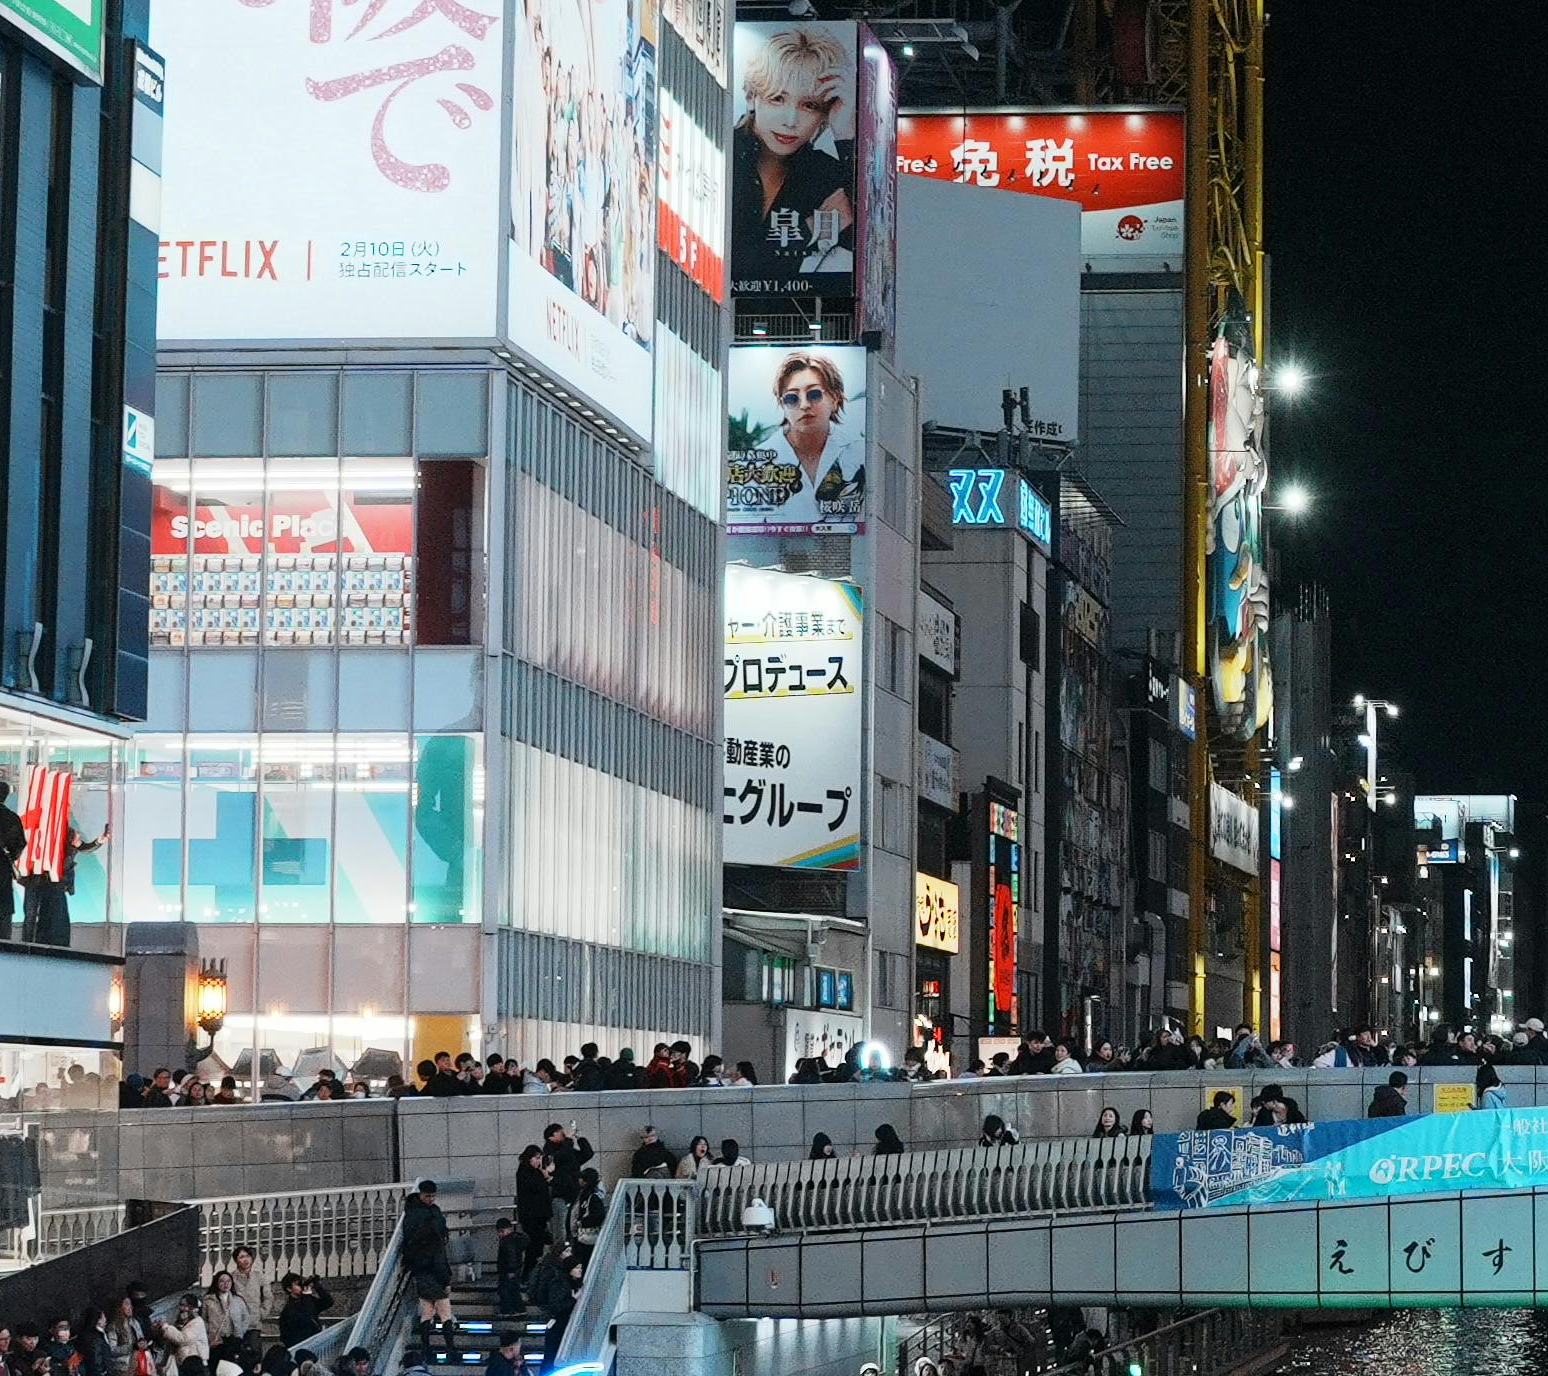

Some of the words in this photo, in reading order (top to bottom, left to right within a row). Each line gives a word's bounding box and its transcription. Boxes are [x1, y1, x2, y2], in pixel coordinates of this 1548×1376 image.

[949, 137, 1076, 188] 免税
[1088, 152, 1124, 172] Tax
[1129, 152, 1174, 172] Free
[157, 239, 280, 281] ETFLIX
[339, 261, 468, 279] 独占配信スタート
[170, 514, 264, 539] Scenic
[272, 514, 339, 539] Plac
[724, 653, 848, 693] プロデュース
[724, 736, 791, 770] 動産業の
